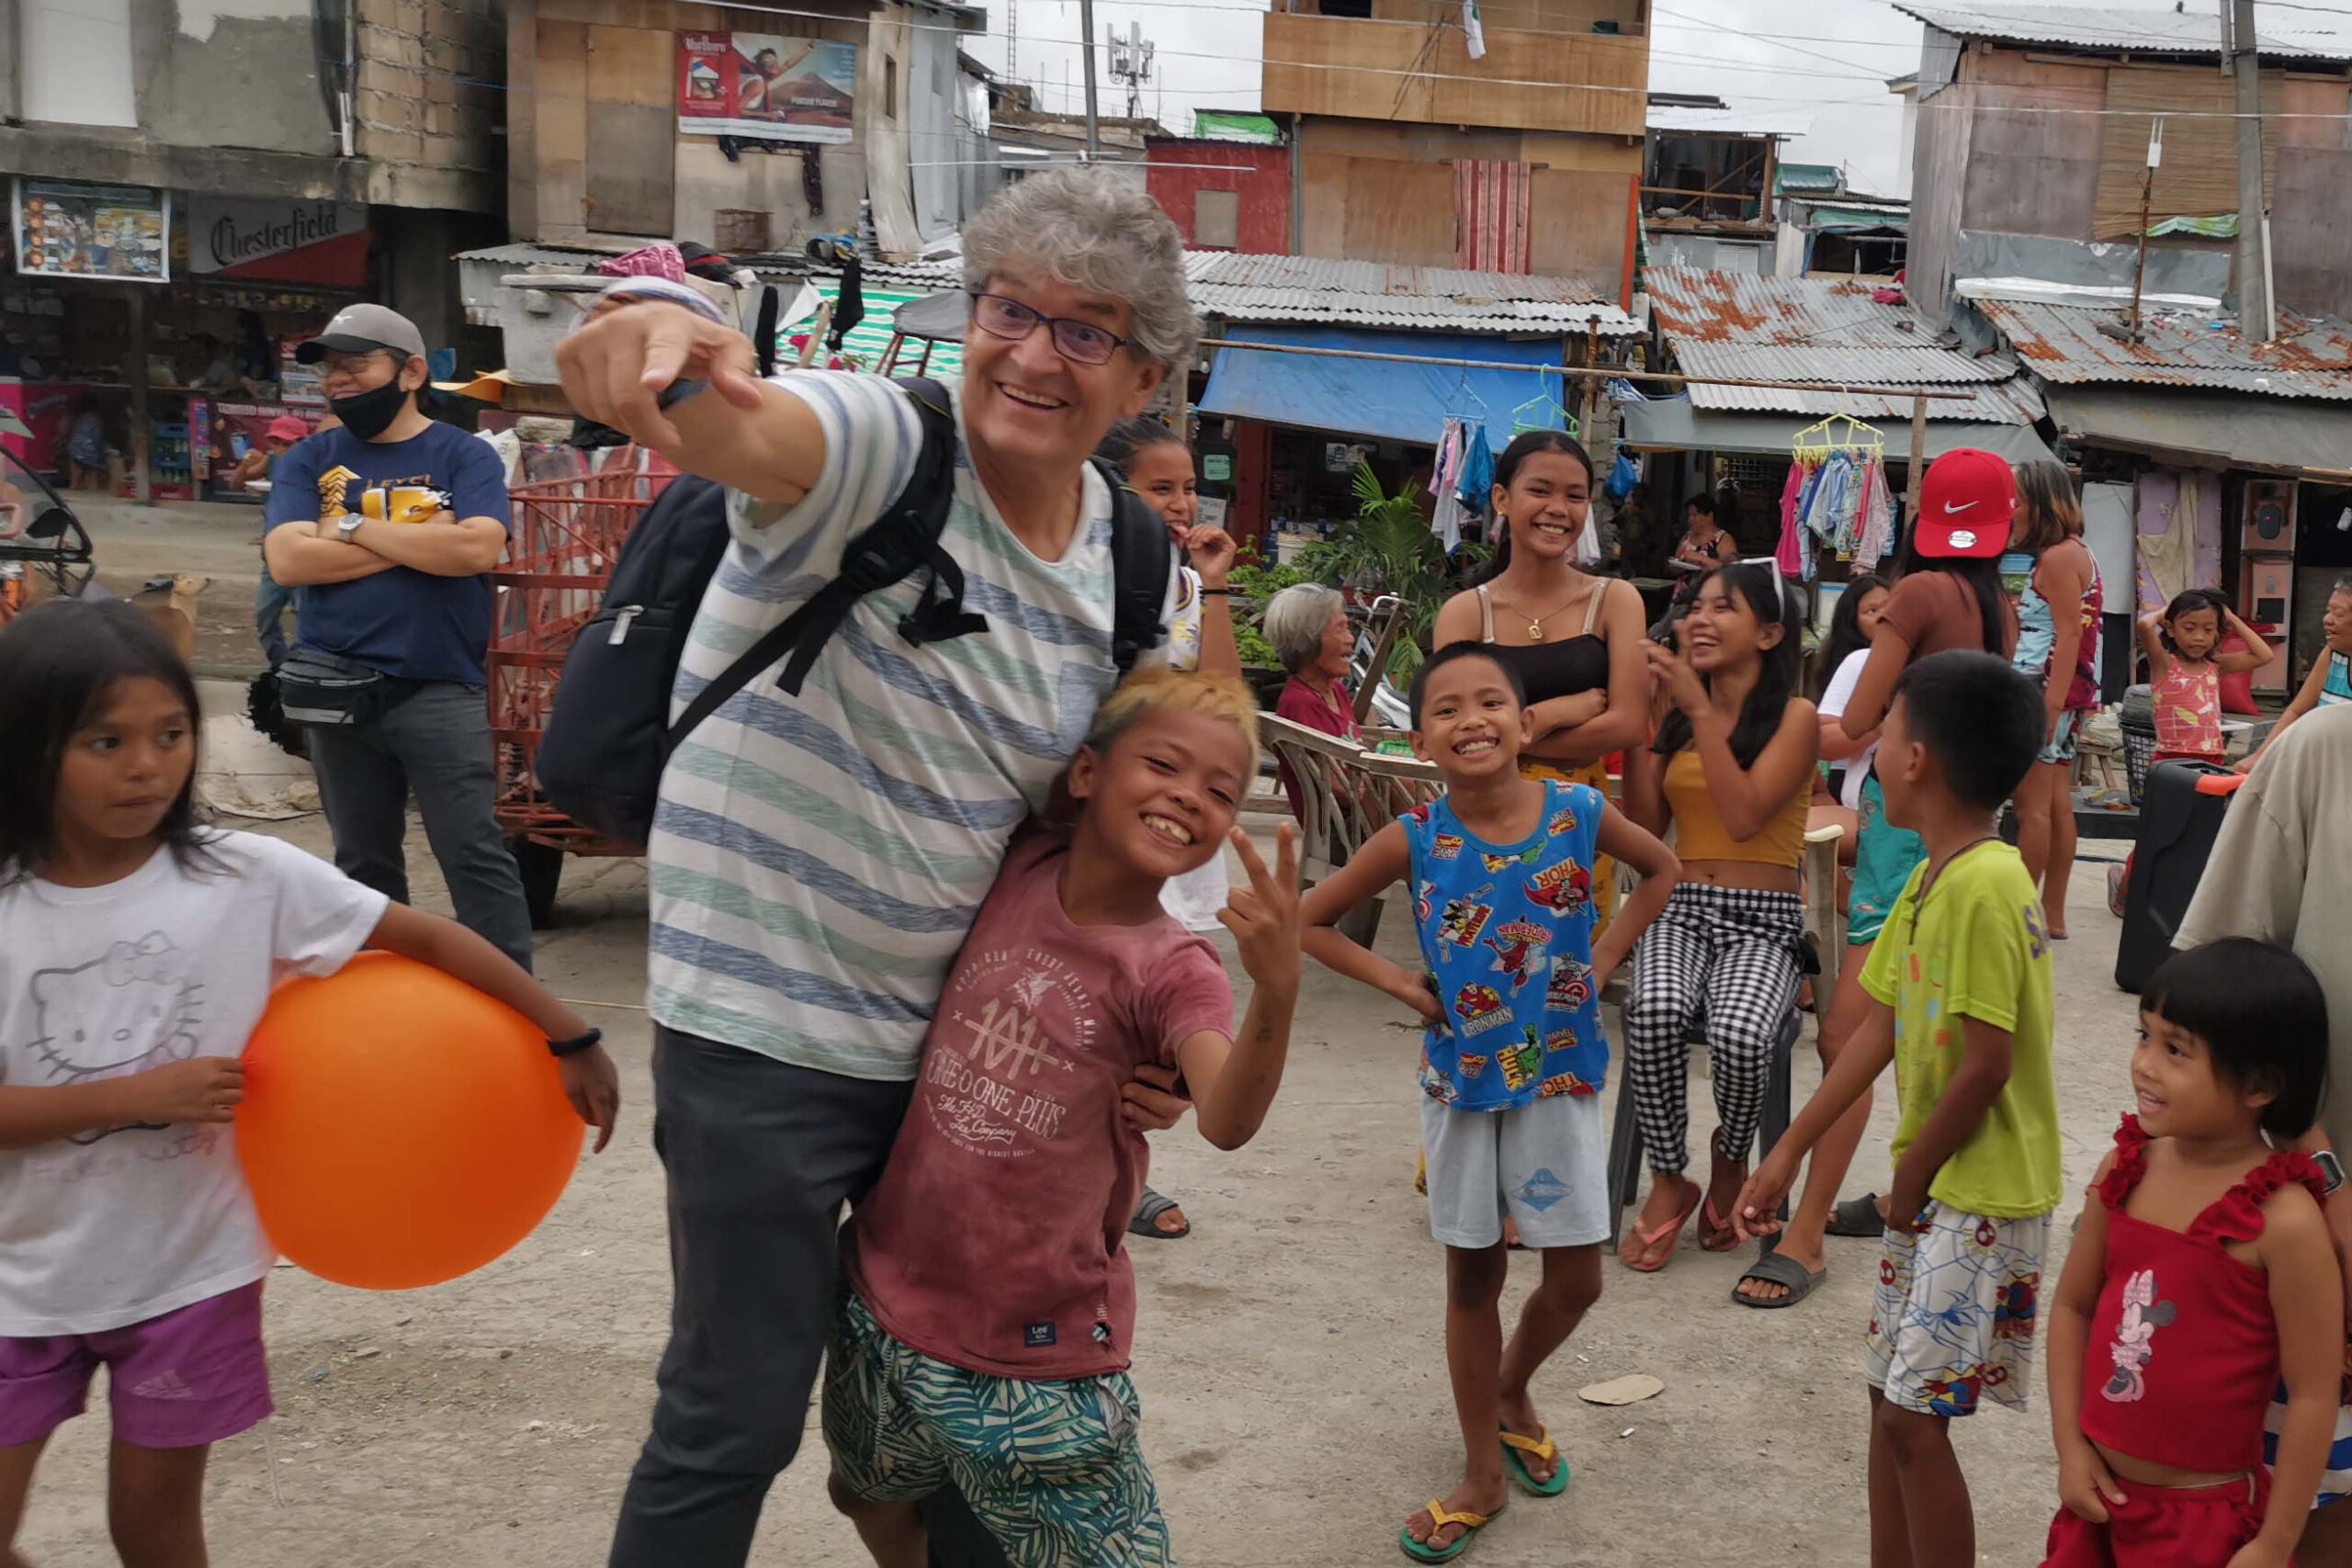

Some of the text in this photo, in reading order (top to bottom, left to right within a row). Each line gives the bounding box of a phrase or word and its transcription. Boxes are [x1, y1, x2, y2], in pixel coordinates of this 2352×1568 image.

[210, 202, 339, 266] Chesterfield
[1535, 859, 1577, 888] THOR
[1497, 1046, 1523, 1091] HULK
[1540, 1073, 1580, 1097] THO
[926, 1049, 962, 1089] ONE
[972, 1076, 1015, 1116] ONE
[1014, 1095, 1067, 1140] PLUS
[972, 1118, 1018, 1142] Company
